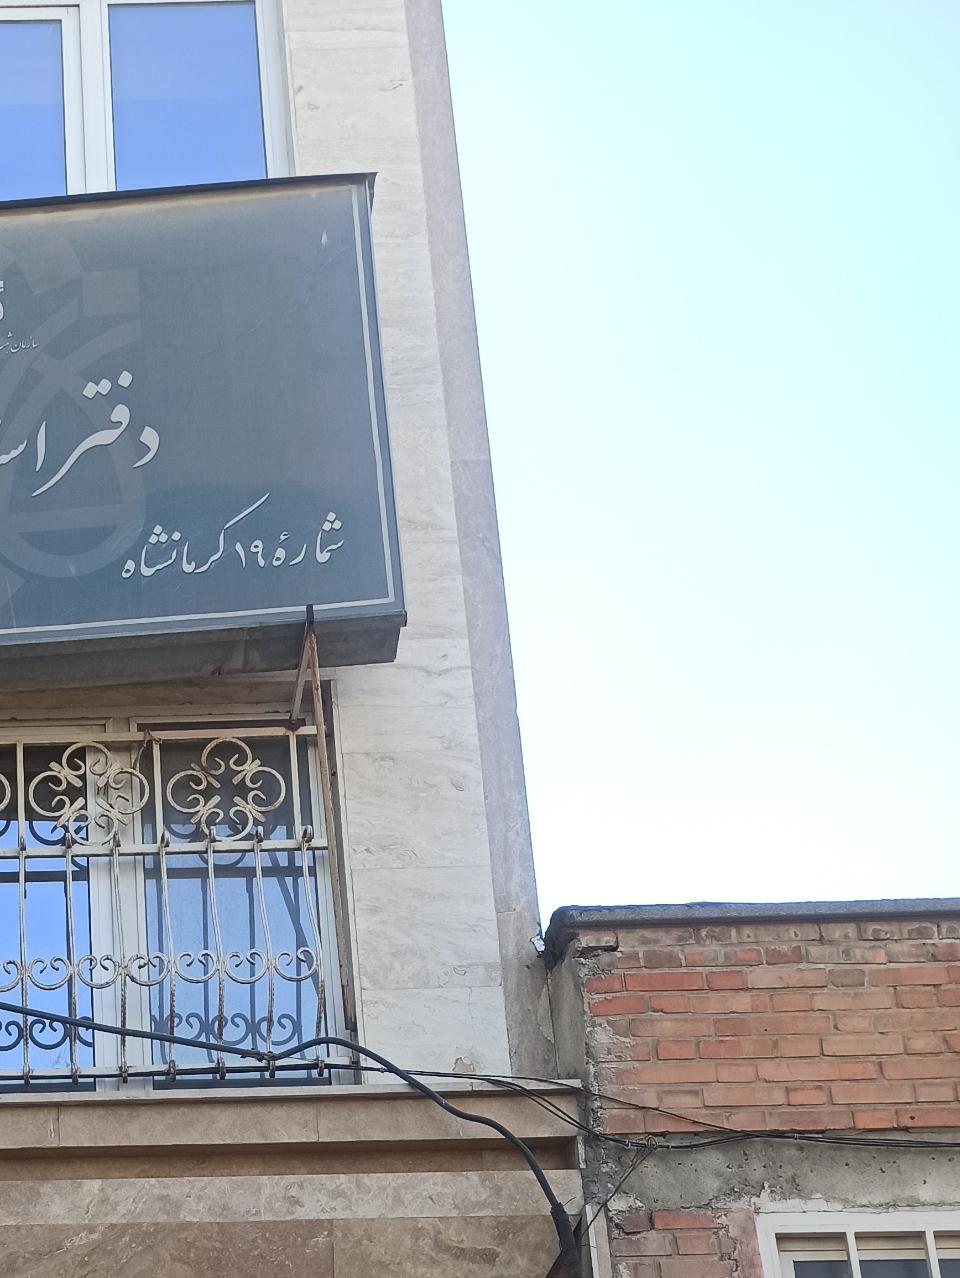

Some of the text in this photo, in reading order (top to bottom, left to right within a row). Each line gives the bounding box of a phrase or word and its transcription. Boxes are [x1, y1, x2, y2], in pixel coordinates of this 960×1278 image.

[10, 336, 40, 353] سازمان
[31, 370, 160, 497] دفتر
[121, 492, 270, 579] کرمانشاه
[235, 539, 265, 568] ۱۹
